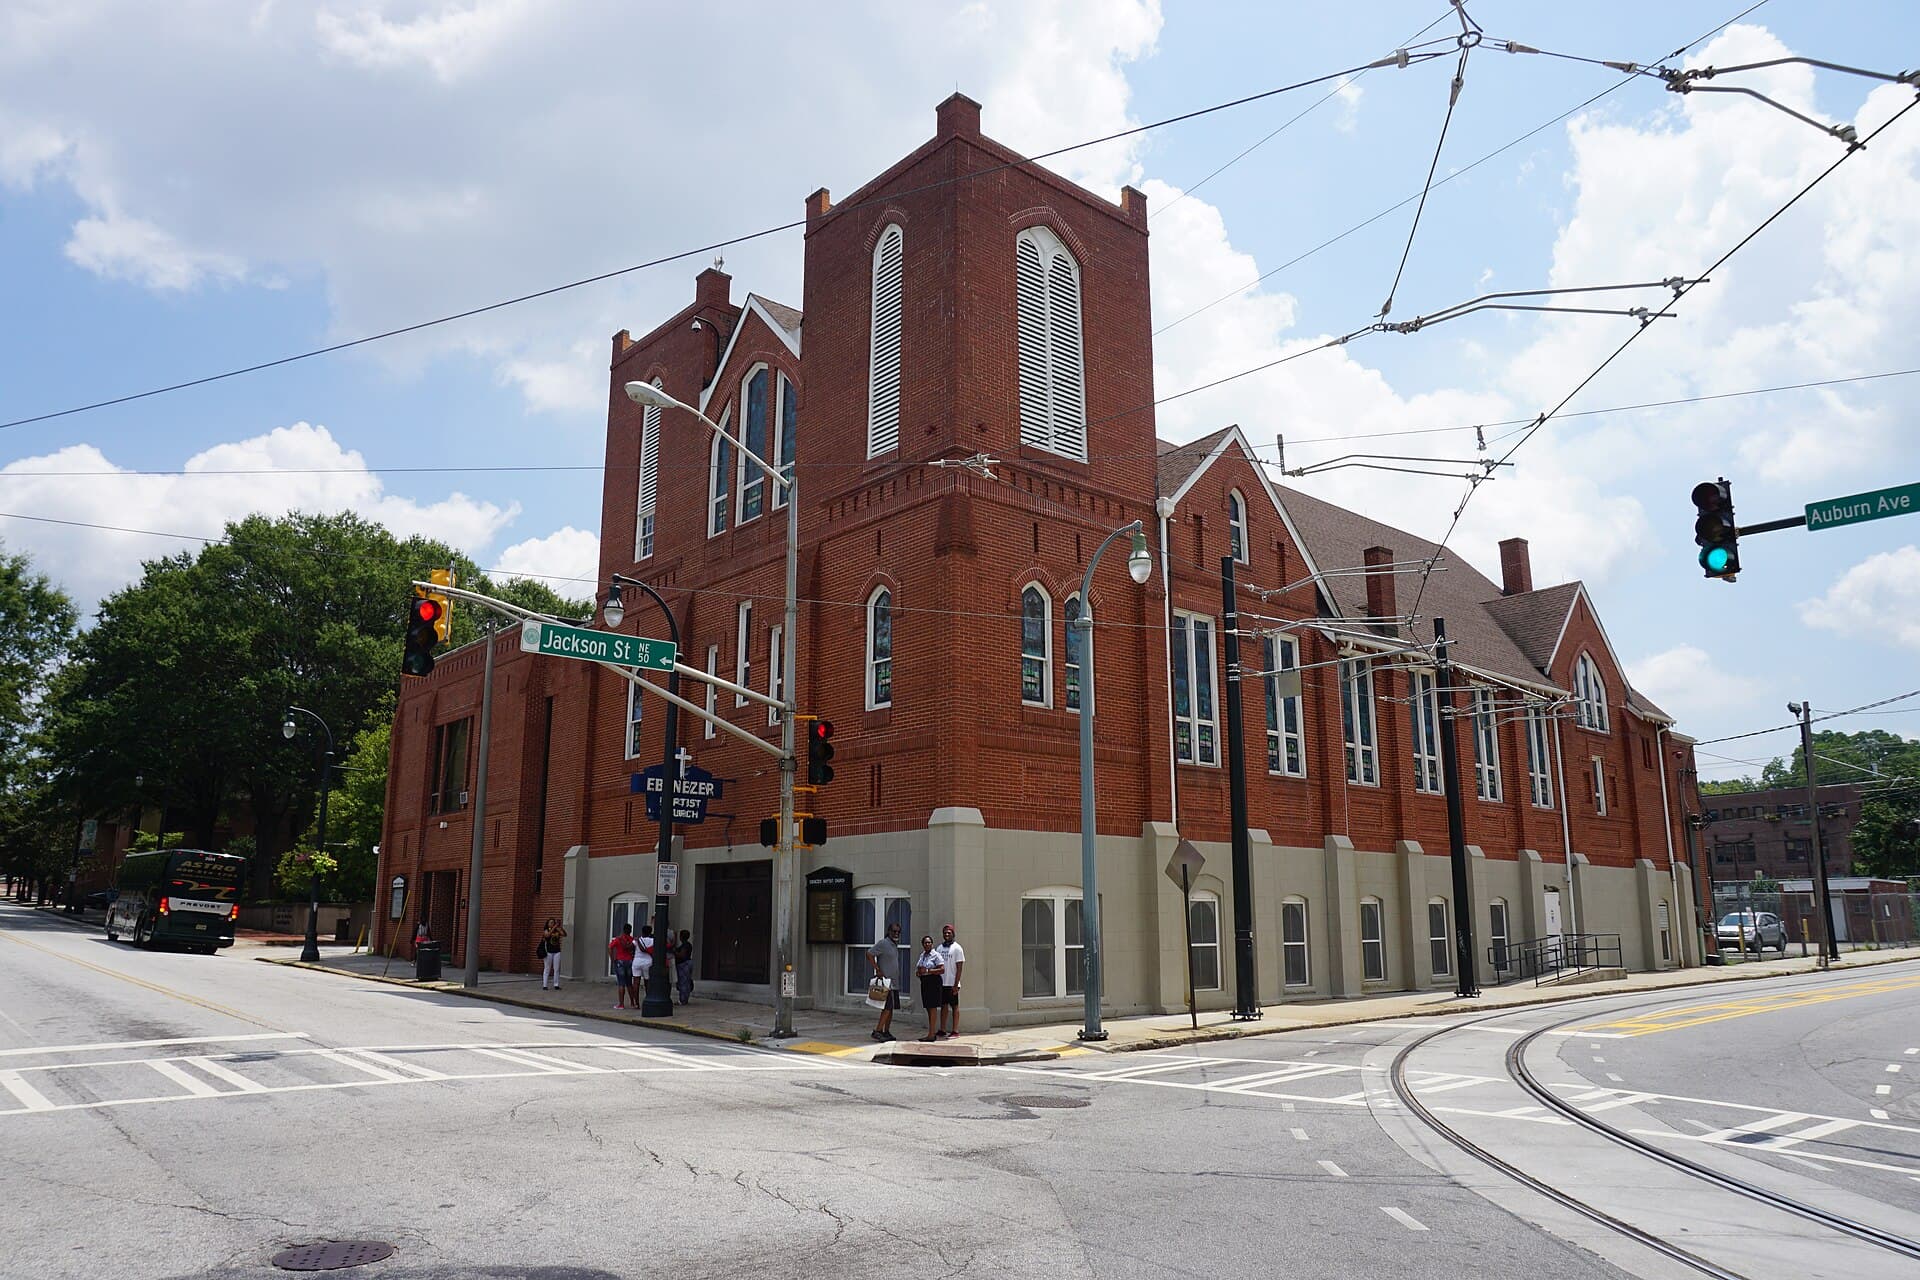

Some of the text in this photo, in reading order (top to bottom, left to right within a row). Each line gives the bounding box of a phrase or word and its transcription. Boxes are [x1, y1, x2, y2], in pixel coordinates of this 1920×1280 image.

[1810, 495, 1910, 525] Auburn Ave
[543, 630, 631, 660] Jackson St
[638, 643, 650, 654] NE
[638, 654, 650, 664] 50
[646, 777, 714, 797] EBNEZER
[180, 860, 237, 872] ASTRO
[180, 901, 221, 909] PREVOST
